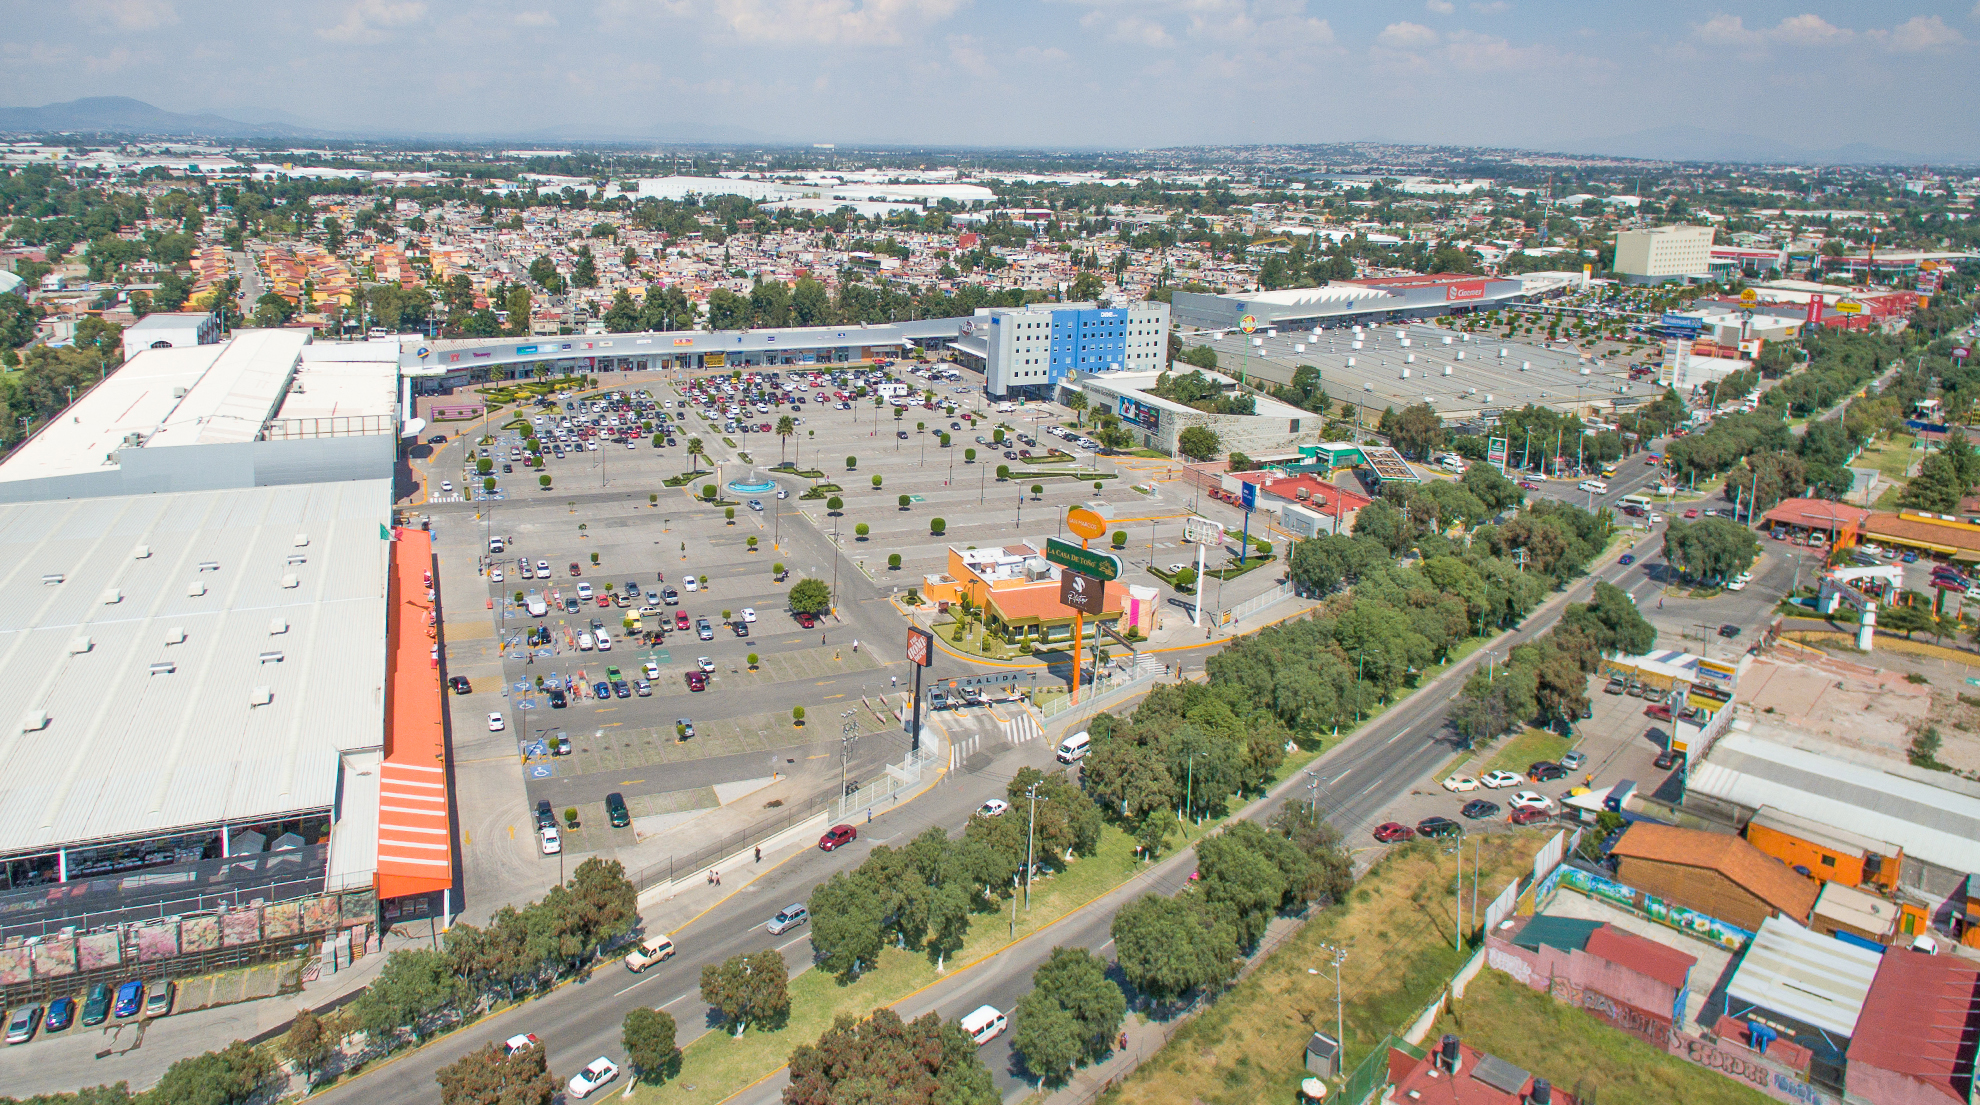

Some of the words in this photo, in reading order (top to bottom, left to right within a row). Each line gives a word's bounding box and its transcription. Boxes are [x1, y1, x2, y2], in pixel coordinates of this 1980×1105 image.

[1047, 546, 1055, 555] LA
[1055, 549, 1070, 560] CASA
[1071, 554, 1080, 563] DE
[907, 635, 928, 659] HOME
[966, 674, 1018, 686] SALIDA
